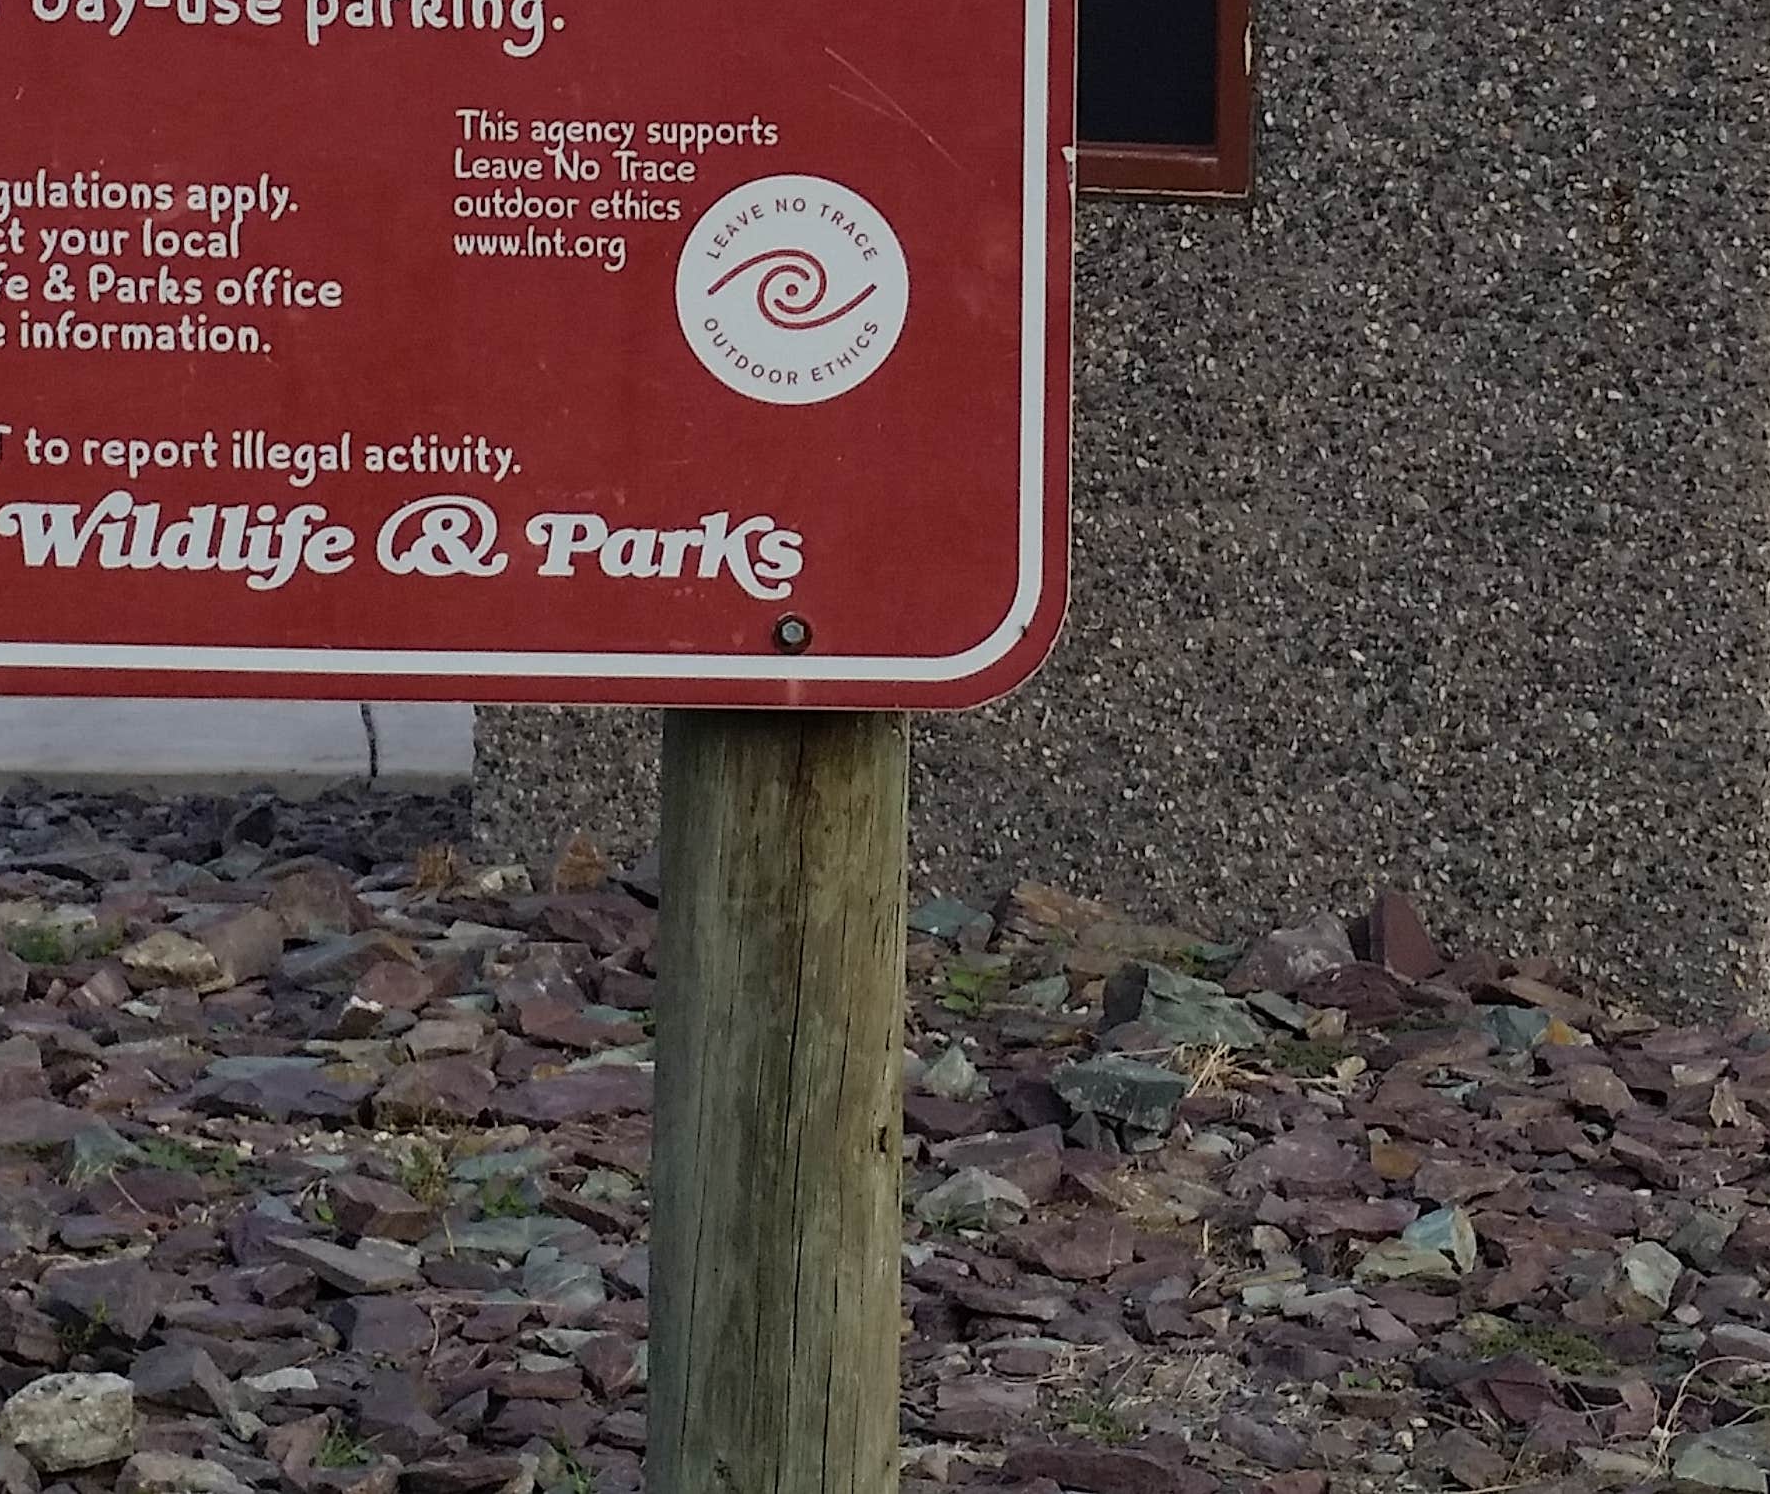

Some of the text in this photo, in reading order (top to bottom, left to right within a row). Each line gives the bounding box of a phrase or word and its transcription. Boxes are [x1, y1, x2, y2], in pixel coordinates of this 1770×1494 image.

[454, 108, 779, 156] This agency supports
[454, 146, 696, 183] Leave No Trace
[186, 172, 299, 223] apply.
[453, 185, 682, 222] outdoor ethics
[38, 227, 131, 264] your
[142, 216, 241, 259] local
[453, 224, 627, 273] www.lnt.org
[706, 197, 878, 262] LEAVE NO TRACE
[42, 262, 77, 303] &
[88, 262, 203, 306] Parks
[215, 266, 343, 308] office
[19, 309, 272, 354] information.
[703, 317, 878, 386] OUTDOOR ETHICS
[23, 427, 71, 466] to
[82, 430, 219, 480] report
[231, 429, 352, 488] illegal
[364, 433, 522, 483] activity.
[375, 494, 510, 578] &
